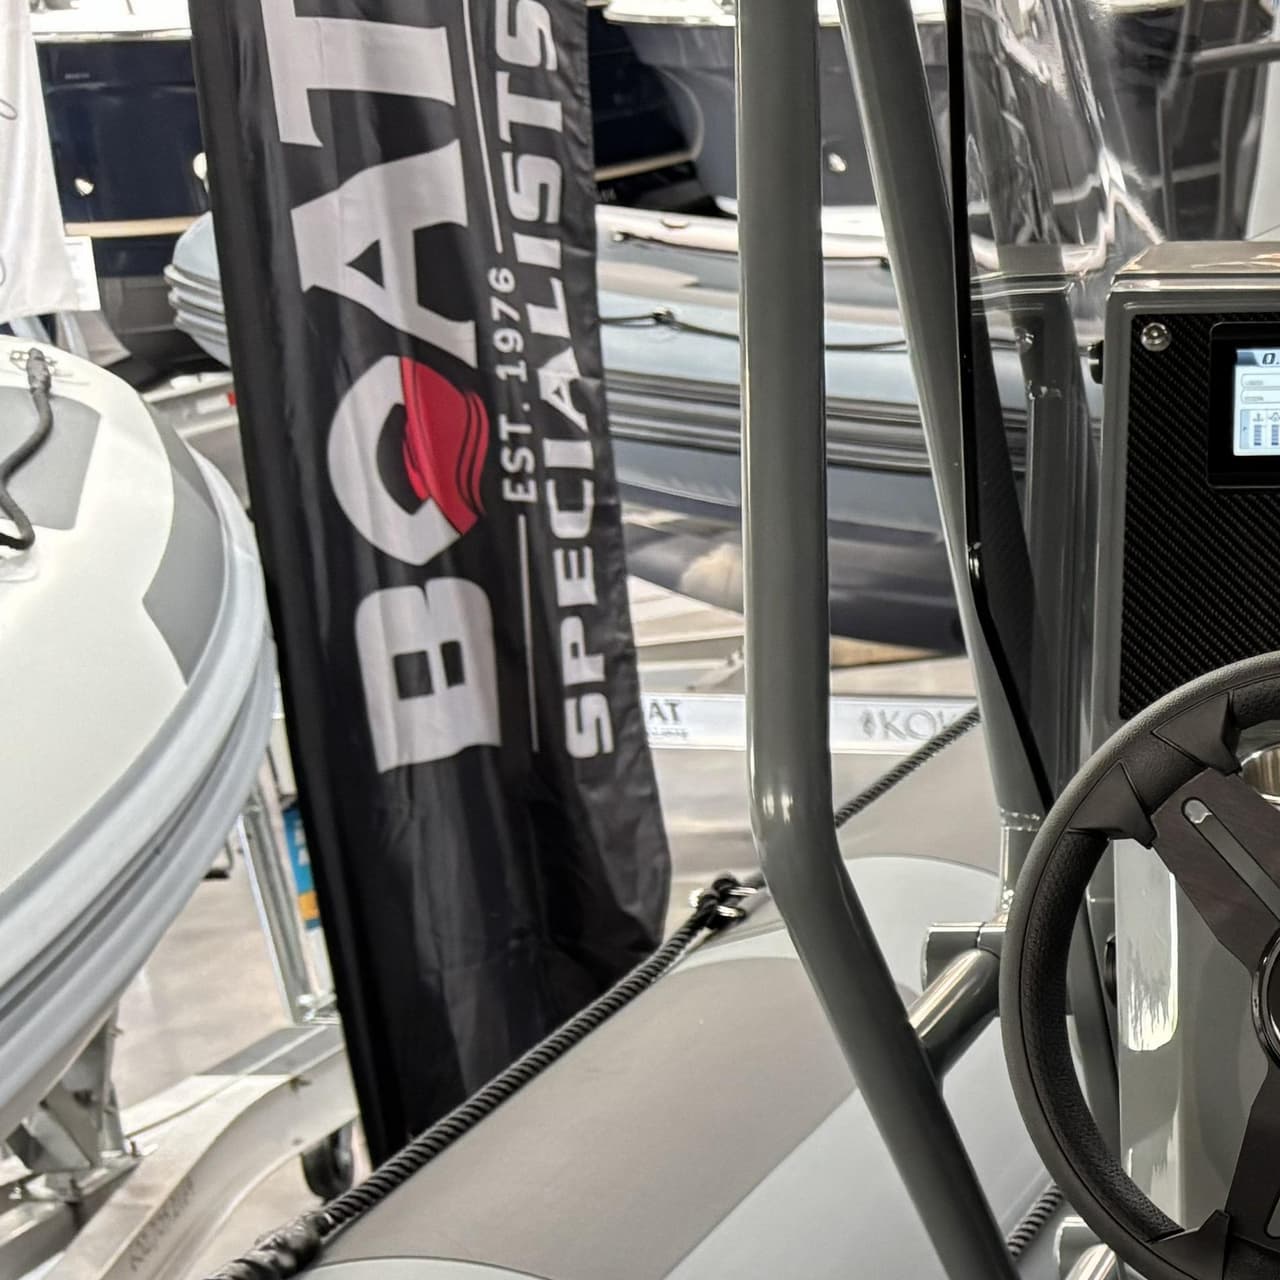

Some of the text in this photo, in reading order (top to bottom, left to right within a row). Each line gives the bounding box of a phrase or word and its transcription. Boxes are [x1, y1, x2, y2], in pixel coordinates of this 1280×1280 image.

[260, 0, 501, 774] BOAT
[489, 265, 538, 505] EST. 1976
[494, 0, 615, 760] SPECIALISTS
